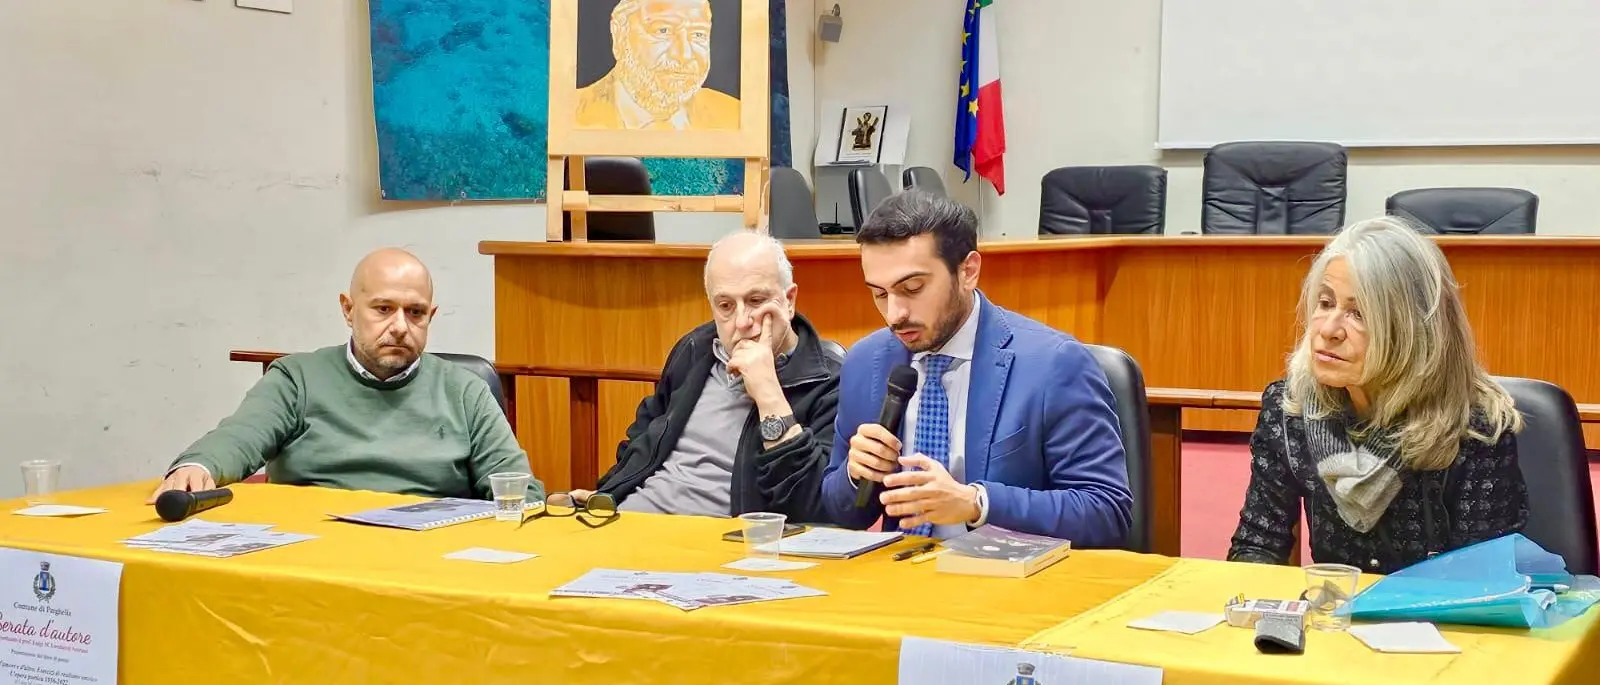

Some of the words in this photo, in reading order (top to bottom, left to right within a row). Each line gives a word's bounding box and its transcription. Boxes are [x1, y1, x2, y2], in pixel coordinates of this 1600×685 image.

[13, 601, 37, 612] Comune
[38, 605, 45, 613] di
[46, 606, 72, 617] Parghelia
[39, 619, 92, 645] d'autore
